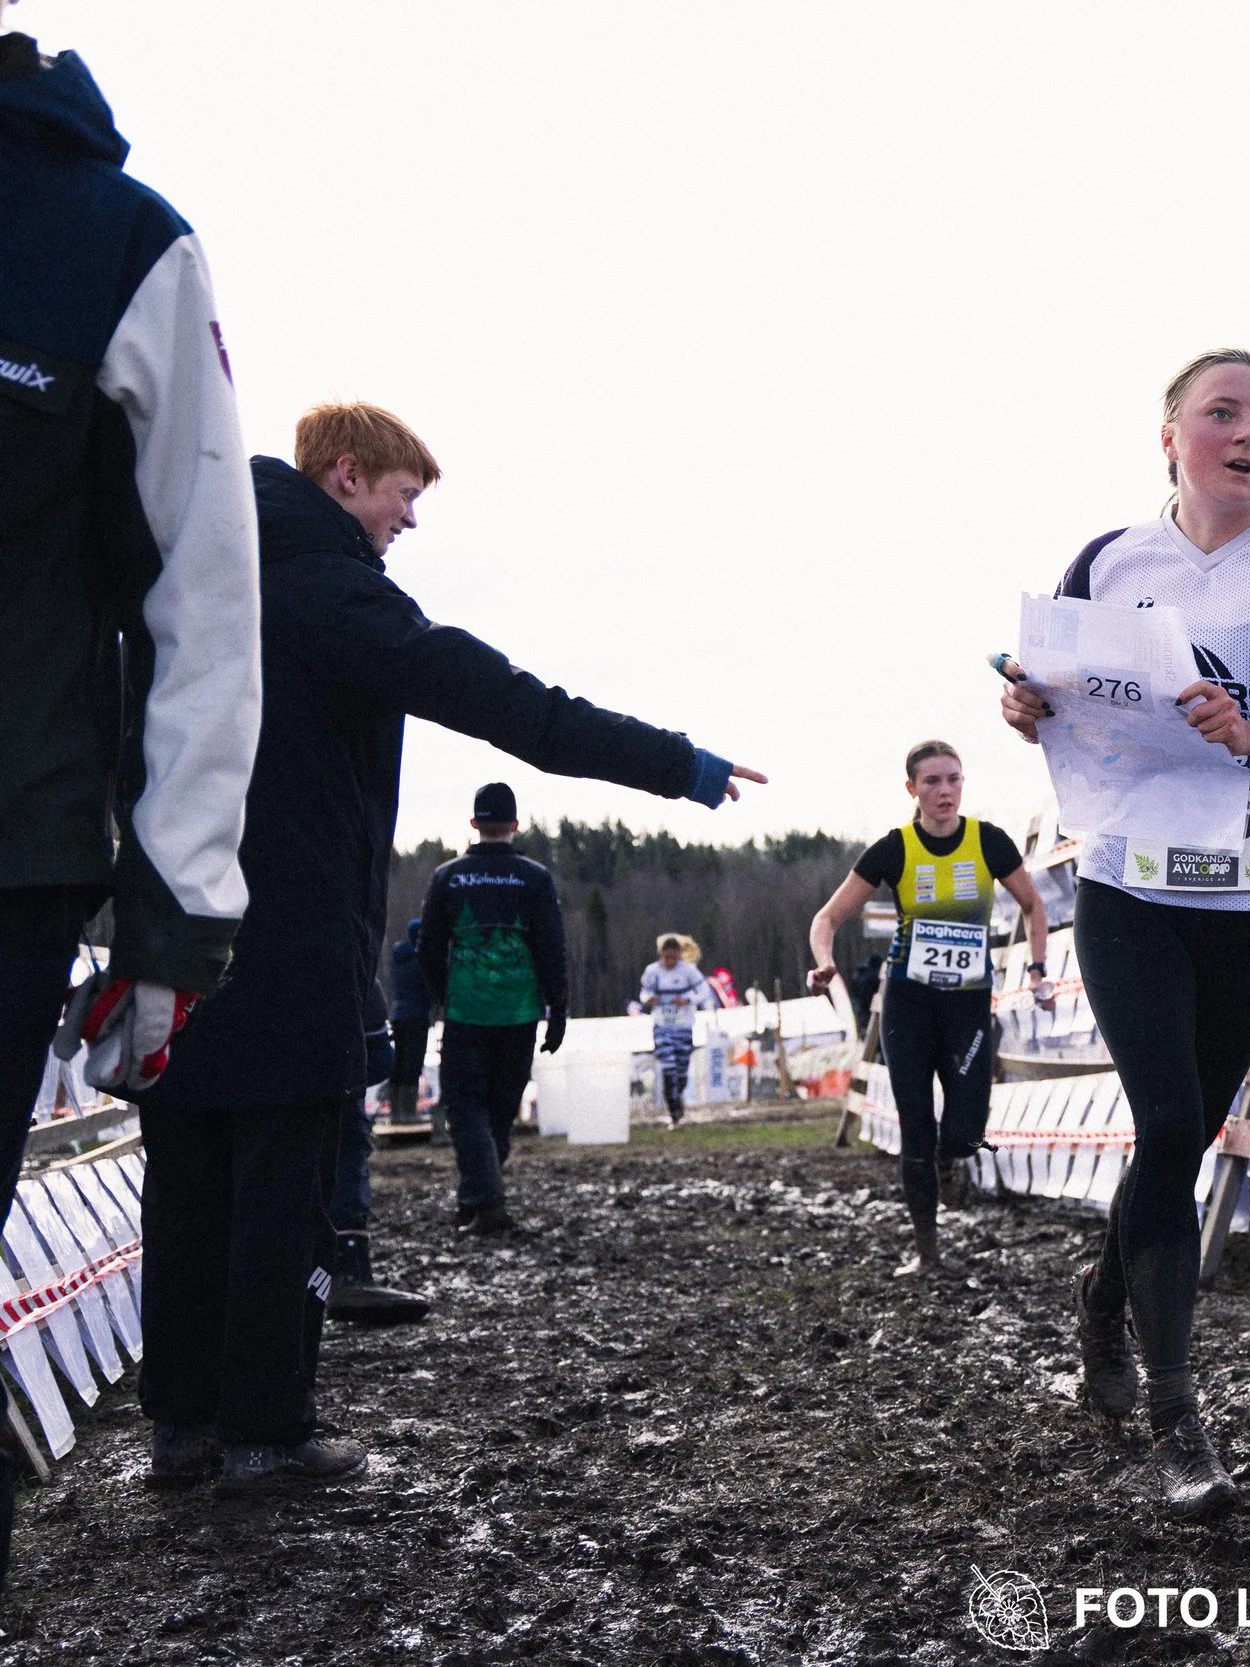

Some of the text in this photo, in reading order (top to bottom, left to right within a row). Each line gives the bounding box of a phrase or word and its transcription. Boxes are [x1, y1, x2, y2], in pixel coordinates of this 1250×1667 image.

[0, 360, 55, 392] wix
[1087, 676, 1142, 702] 276
[1172, 852, 1231, 863] GODKÄNDA
[916, 923, 983, 940] bagheera
[923, 947, 971, 969] 218
